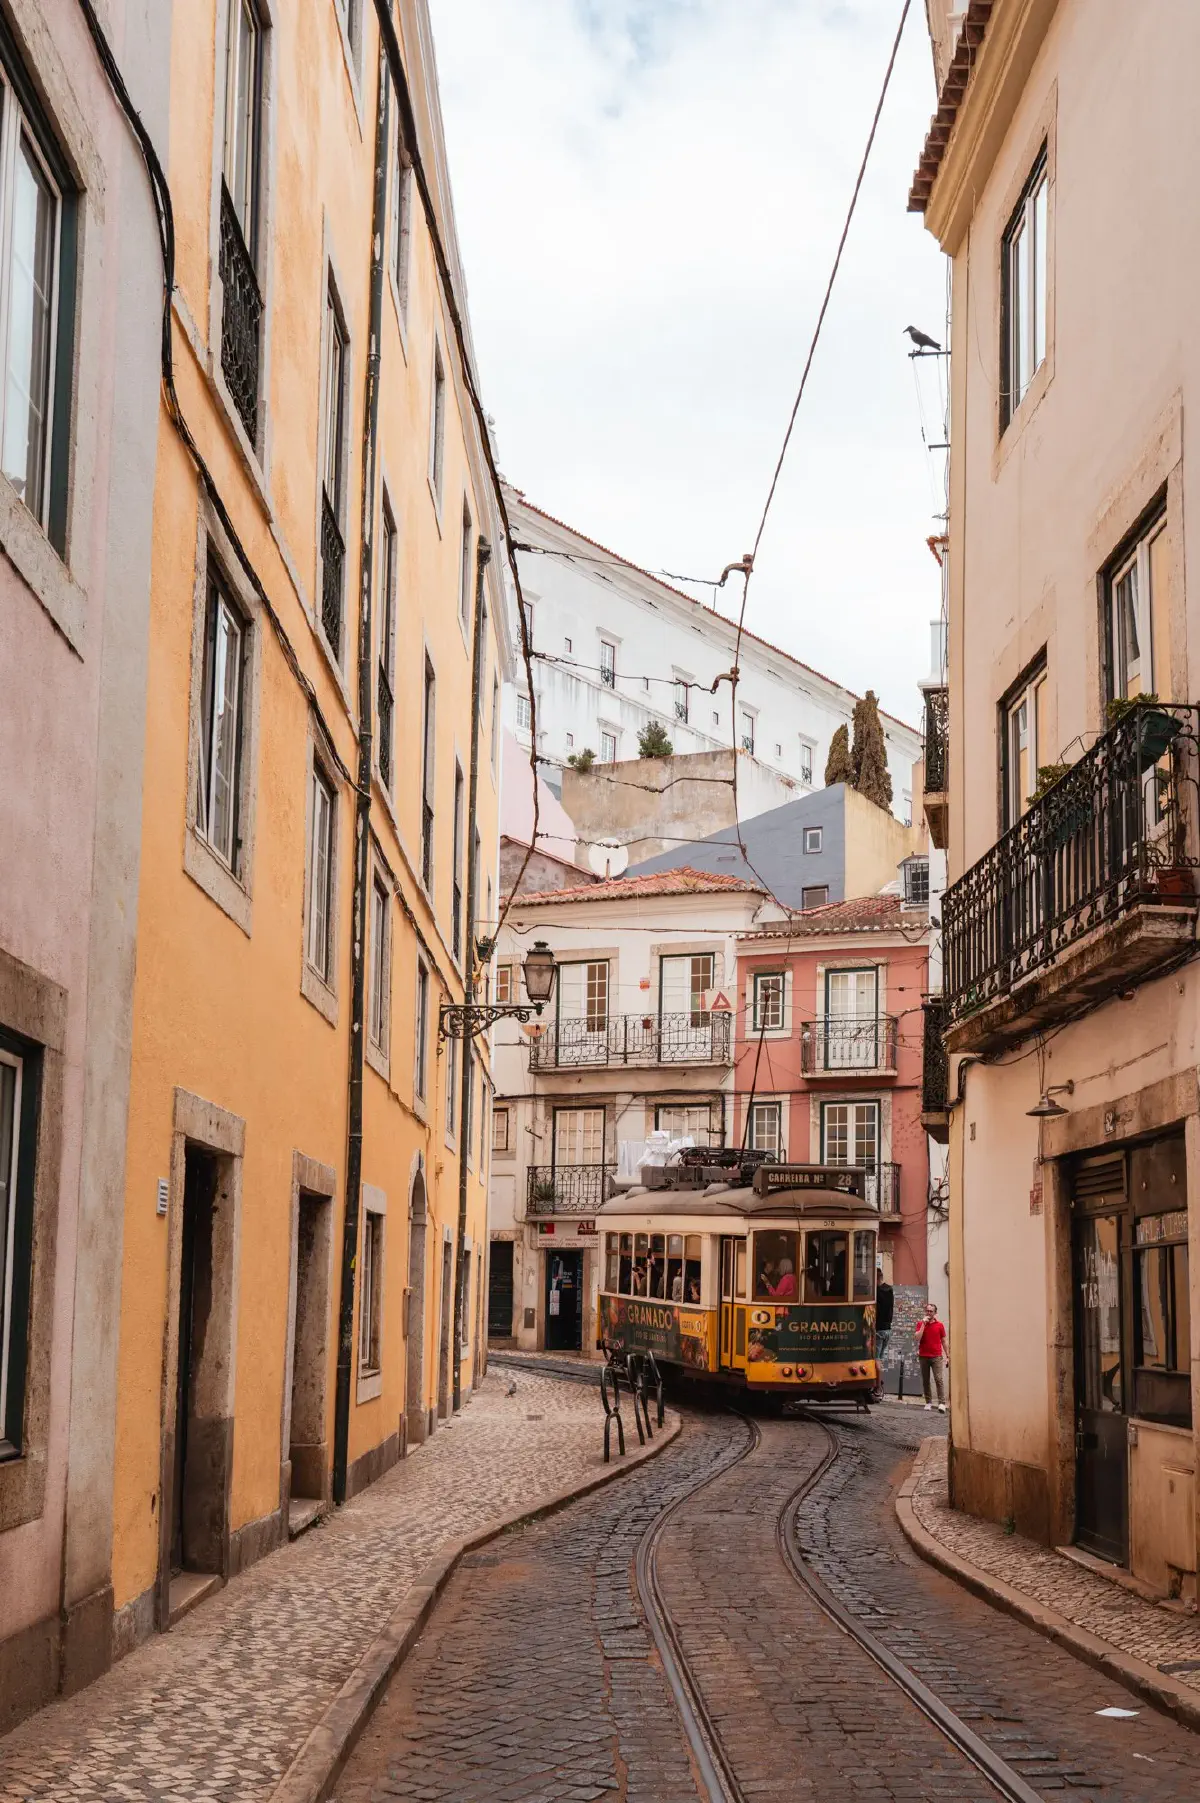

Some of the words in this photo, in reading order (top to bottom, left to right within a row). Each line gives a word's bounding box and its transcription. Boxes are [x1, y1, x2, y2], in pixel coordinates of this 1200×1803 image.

[768, 1173, 810, 1183] CARREIRA
[837, 1174, 852, 1186] 28
[627, 1304, 673, 1330] GRANADO
[788, 1321, 857, 1333] GRANADO
